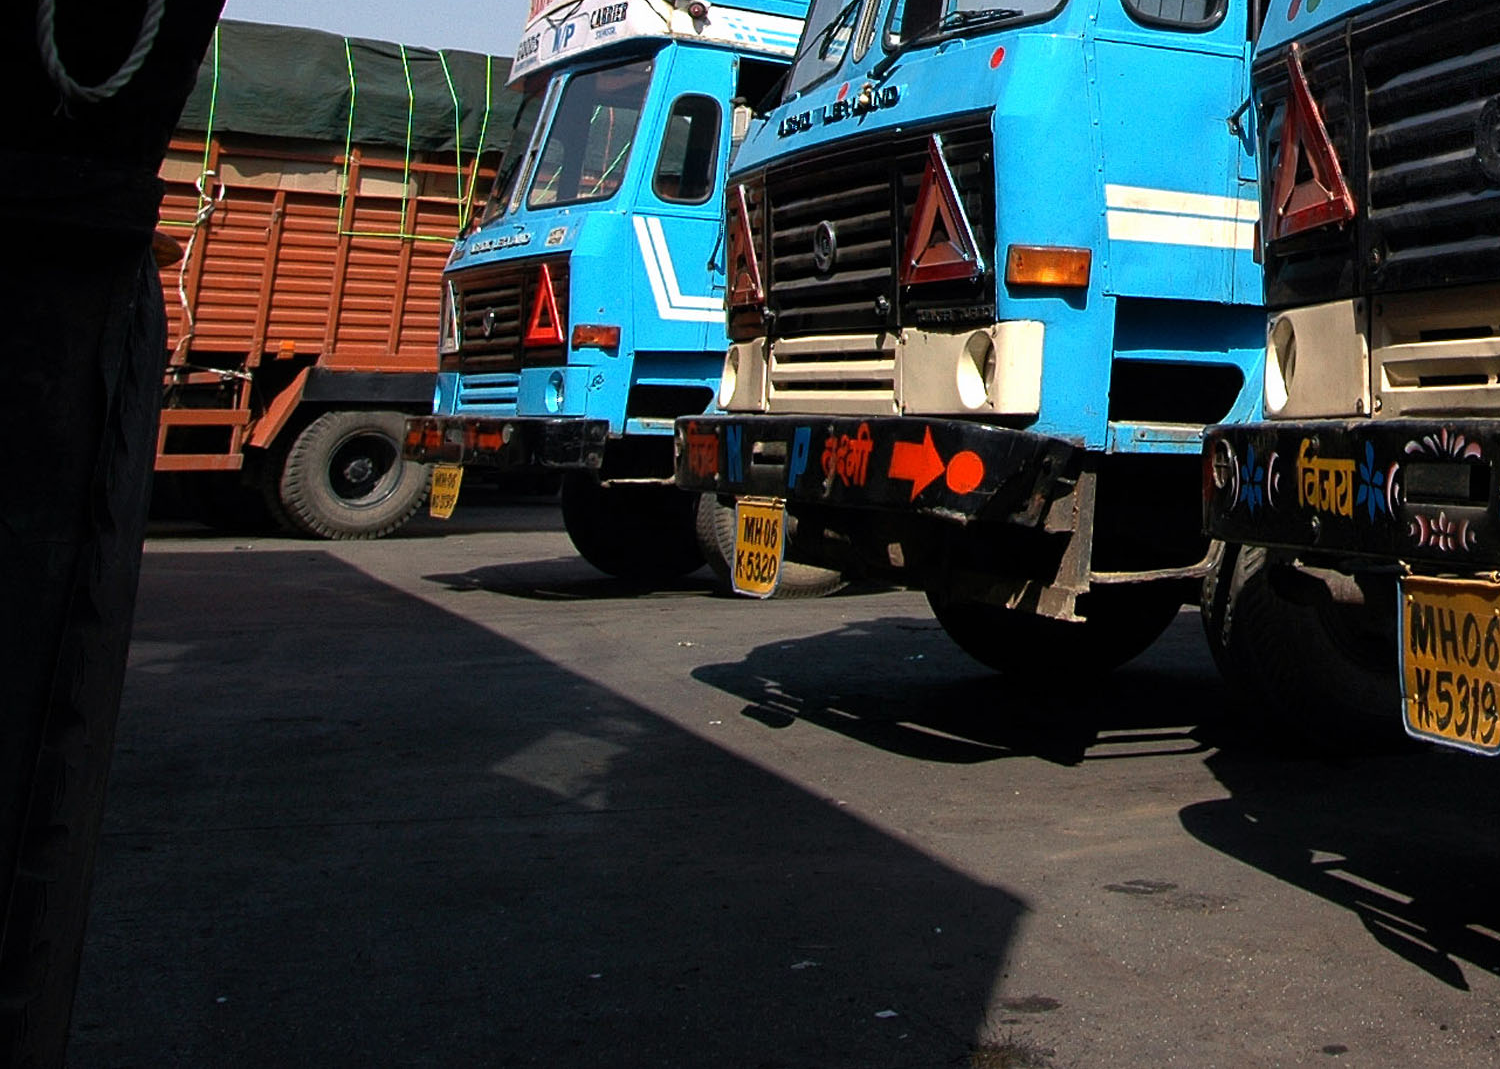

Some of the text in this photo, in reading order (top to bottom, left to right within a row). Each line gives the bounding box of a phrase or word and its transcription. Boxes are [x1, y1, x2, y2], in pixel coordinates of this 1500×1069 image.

[590, 1, 629, 30] CARRIER
[787, 426, 812, 488] P
[1297, 437, 1357, 520] विजय
